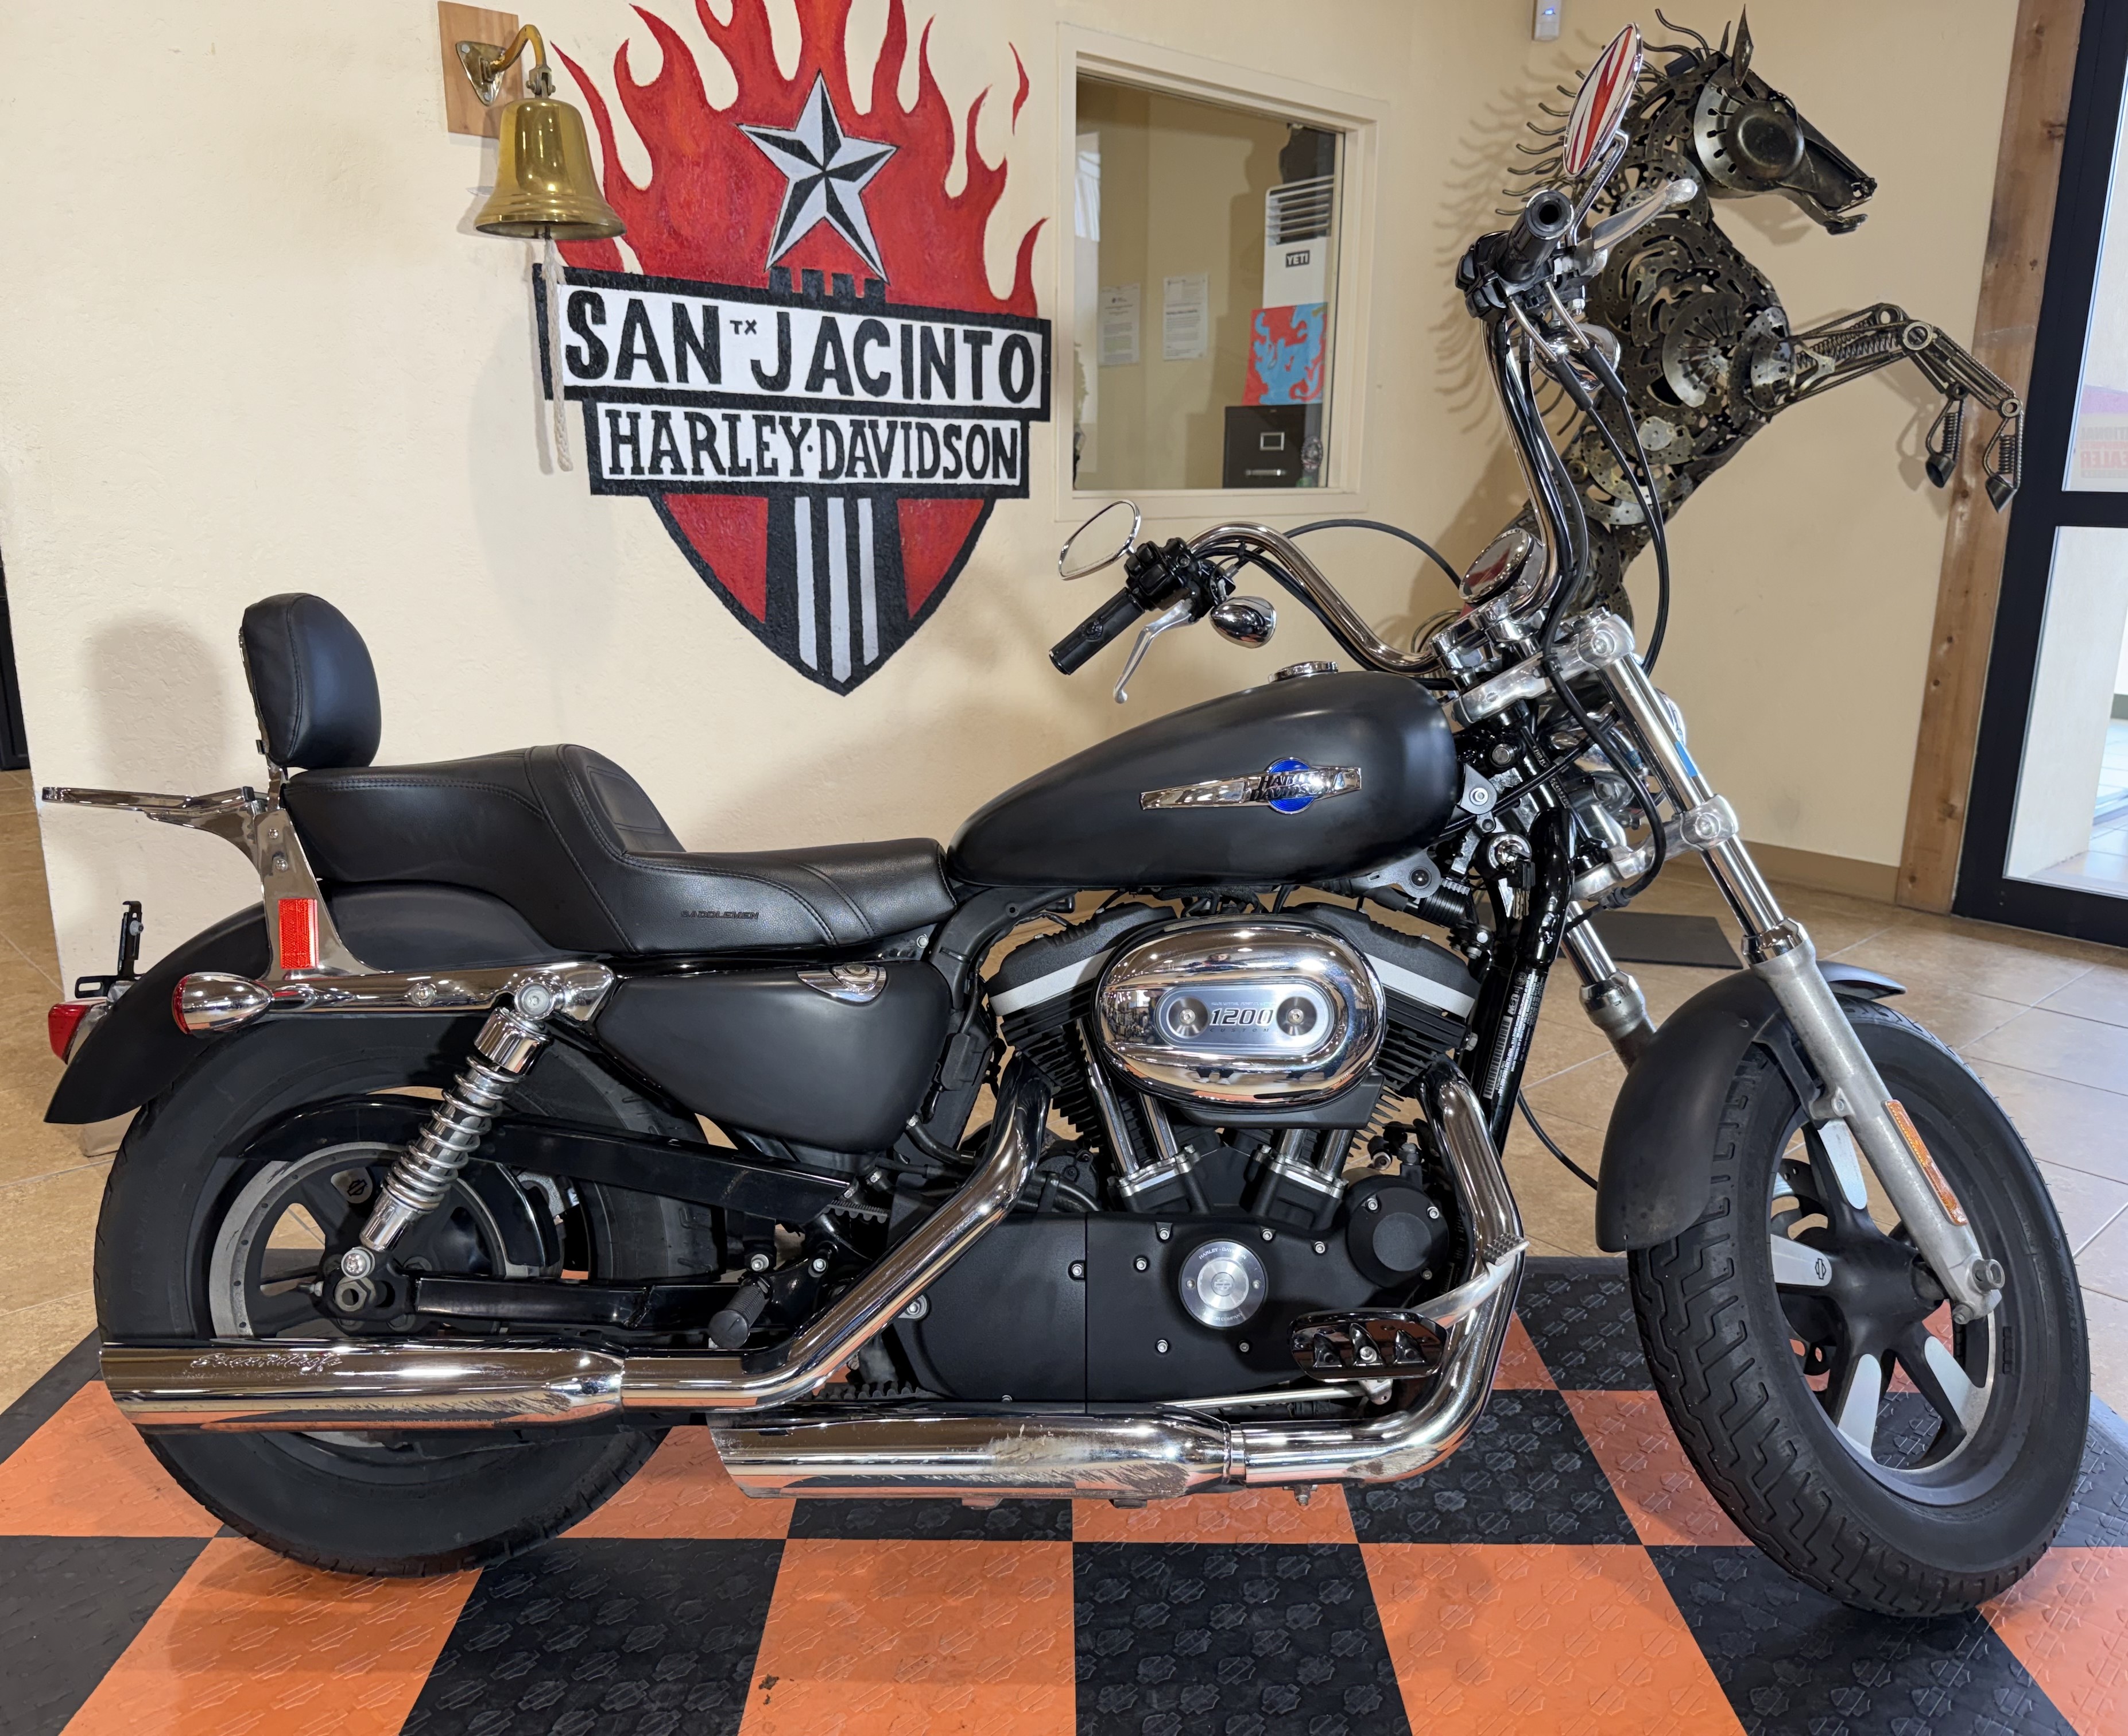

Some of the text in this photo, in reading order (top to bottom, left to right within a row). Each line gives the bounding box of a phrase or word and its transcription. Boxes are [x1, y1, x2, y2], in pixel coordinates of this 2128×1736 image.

[1286, 253, 1308, 265] YETI
[730, 319, 758, 336] TX
[566, 290, 722, 384] SAN
[751, 312, 1034, 404] JACINTO
[681, 910, 759, 919] SADDLEMEN
[1210, 1008, 1274, 1026] 1200
